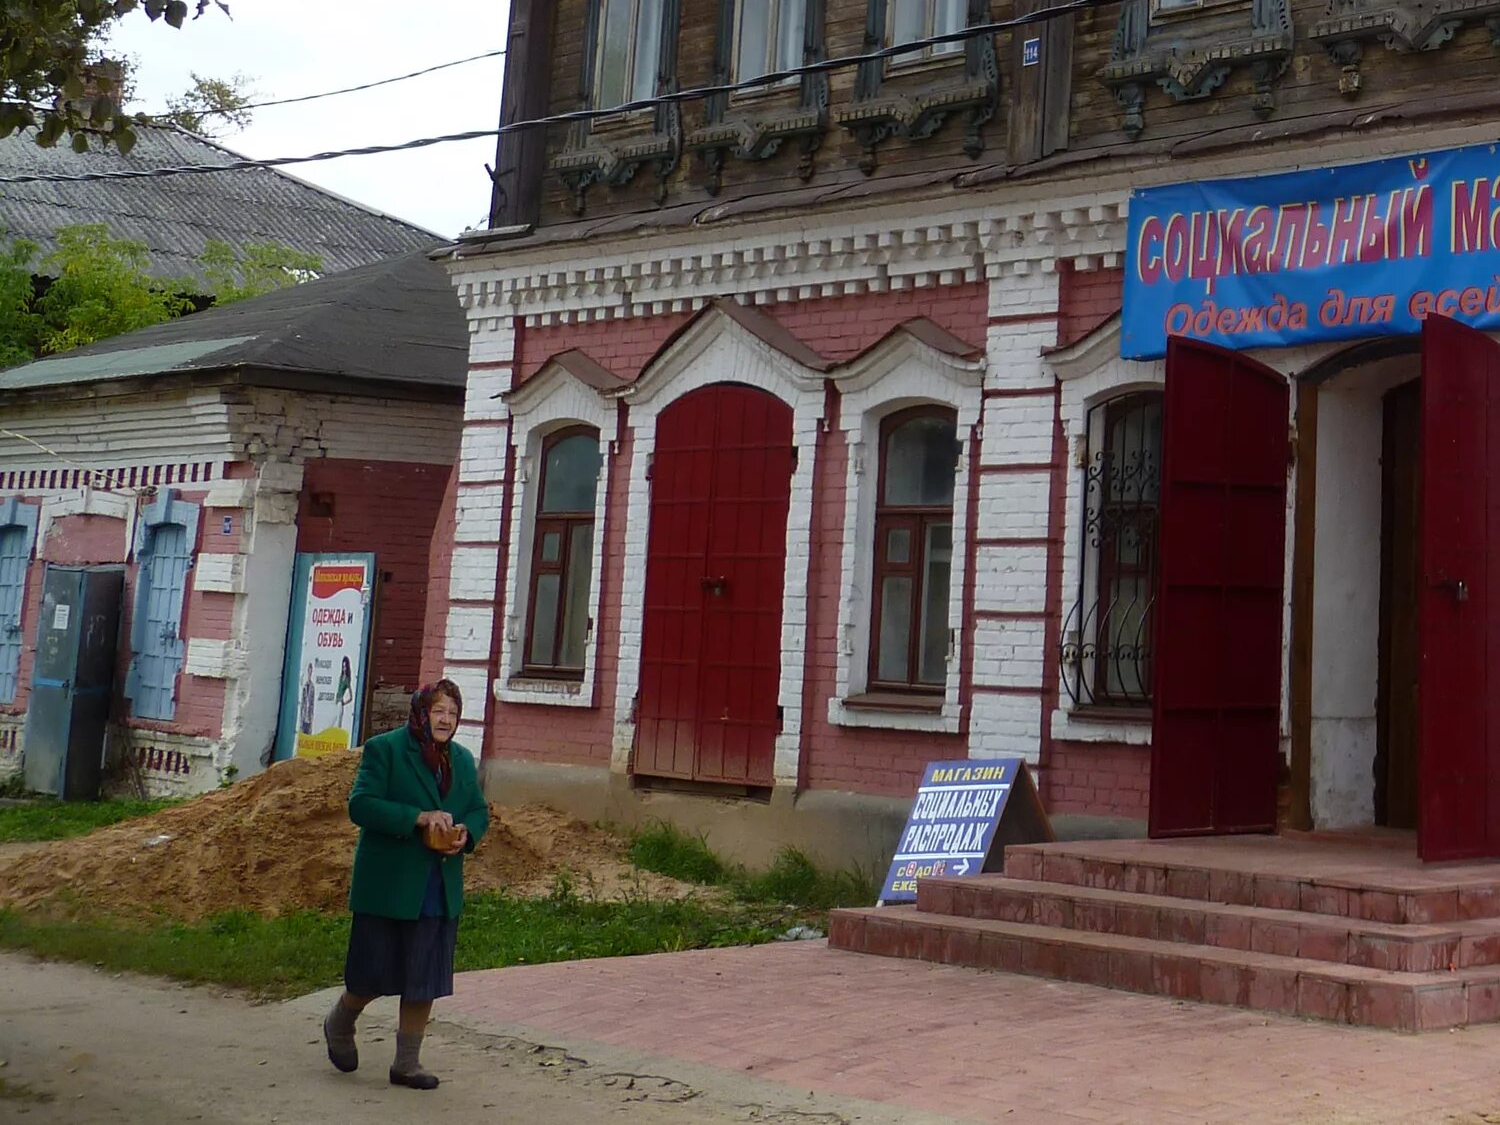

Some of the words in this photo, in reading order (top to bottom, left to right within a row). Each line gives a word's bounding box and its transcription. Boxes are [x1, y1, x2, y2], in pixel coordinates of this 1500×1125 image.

[1165, 291, 1308, 337] Одежда
[1319, 288, 1396, 327] для
[312, 608, 346, 626] ОДЕЖДА
[317, 632, 344, 648] ОБУВЬ
[931, 766, 1005, 782] МАГАЗИН
[912, 790, 1003, 823] СОЦИАЛЬНЫХ
[902, 823, 989, 855] РАСПРОДАЖ
